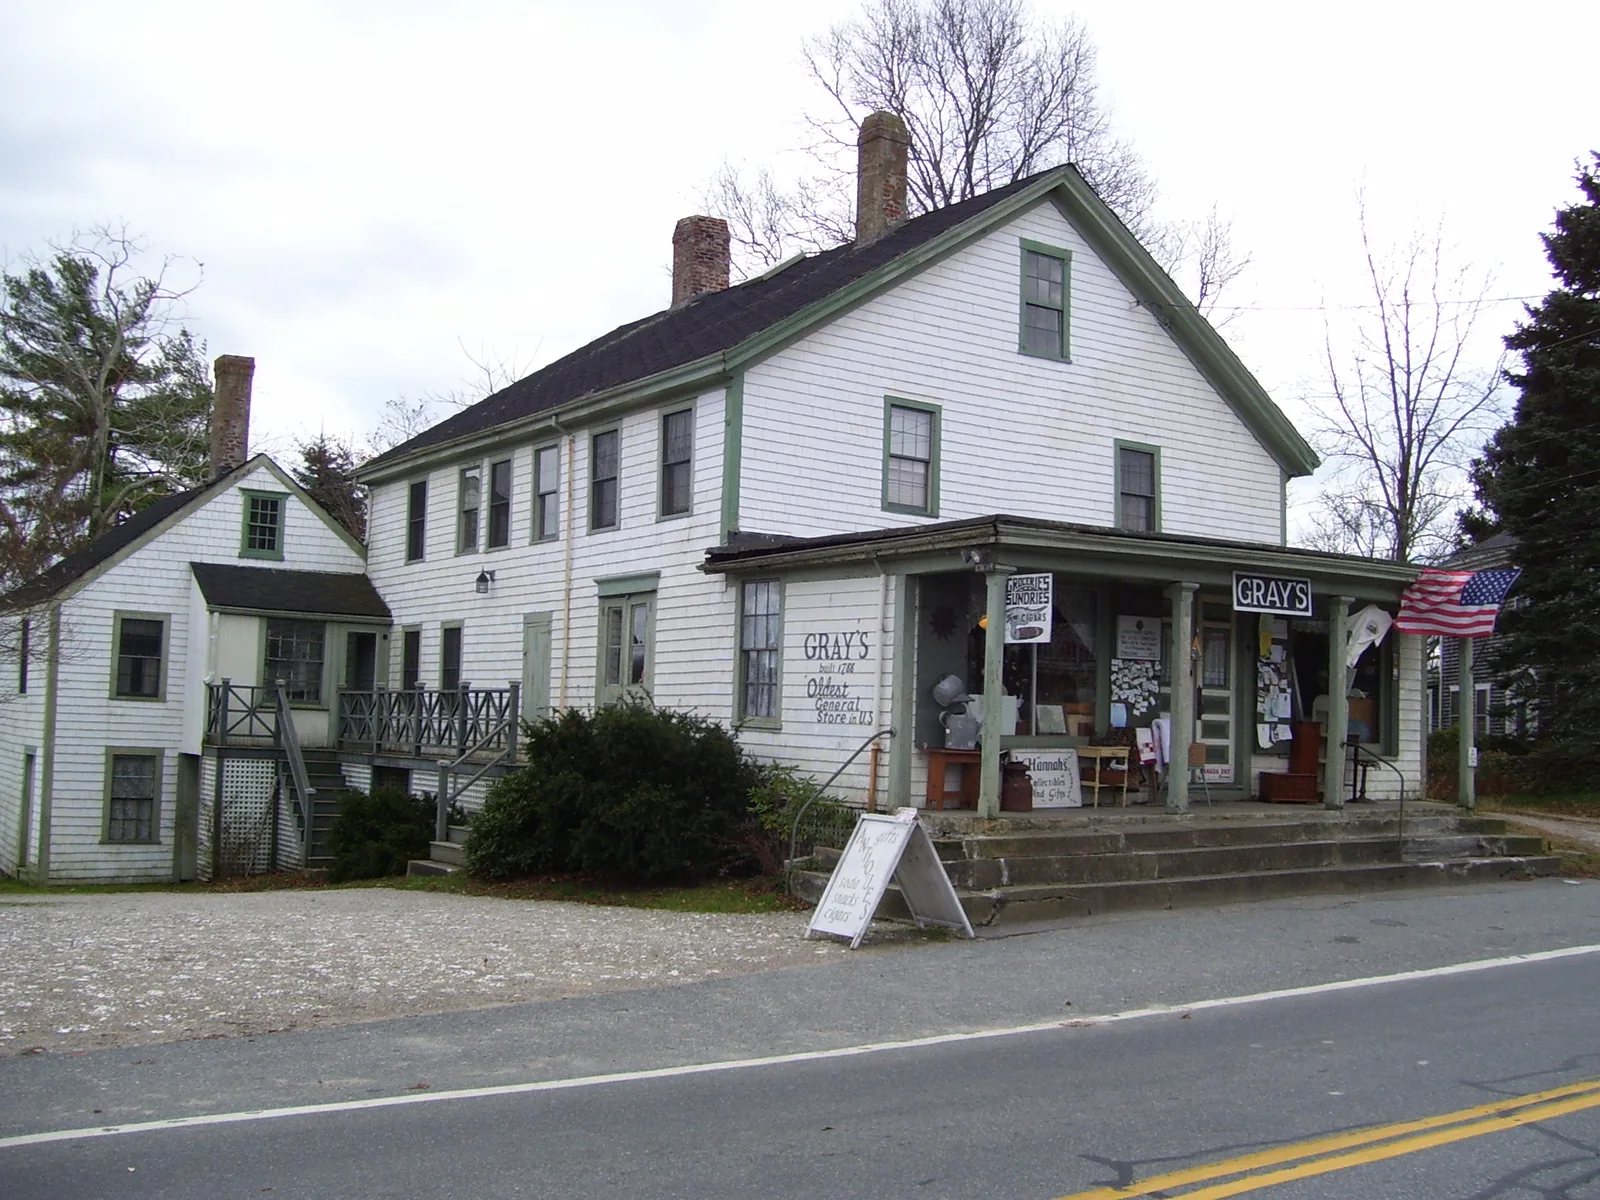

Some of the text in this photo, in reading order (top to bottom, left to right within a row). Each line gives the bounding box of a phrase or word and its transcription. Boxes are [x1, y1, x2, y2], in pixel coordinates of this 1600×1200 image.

[1006, 576, 1050, 593] GROCERIES
[1006, 592, 1050, 606] SUNDRIES
[1237, 578, 1308, 609] GRAY'S
[1020, 613, 1047, 623] CIGARS
[804, 629, 869, 660] GRAY'S
[807, 676, 850, 699] Oldest
[814, 696, 861, 712] General
[816, 710, 847, 724] Store
[849, 713, 857, 724] in
[1033, 777, 1066, 788] ollectibles
[873, 826, 900, 847] gifts
[838, 875, 861, 890] soda
[831, 892, 860, 907] snacks
[823, 907, 852, 924] cigars
